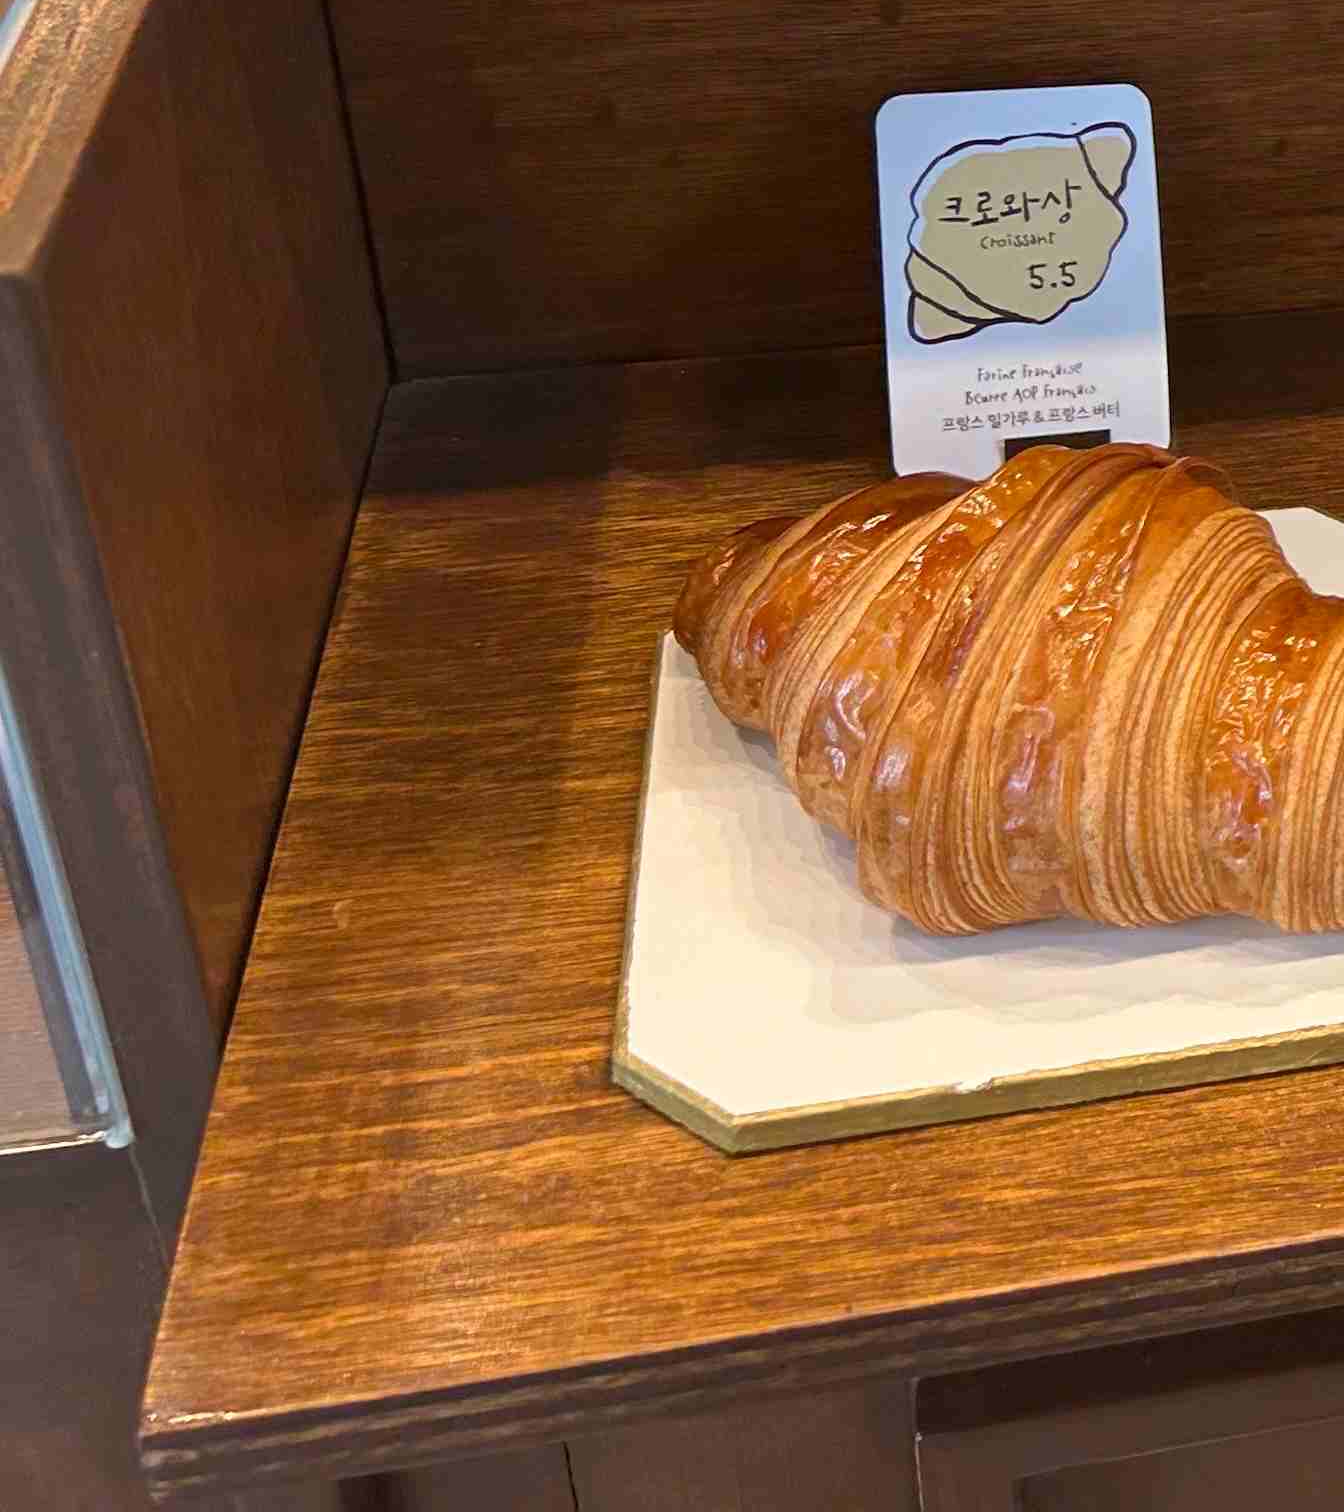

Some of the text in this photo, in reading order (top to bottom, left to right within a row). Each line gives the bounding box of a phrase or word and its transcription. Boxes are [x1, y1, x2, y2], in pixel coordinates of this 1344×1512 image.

[938, 178, 1083, 228] 크로와상
[1026, 261, 1078, 289] 5.5
[941, 414, 985, 433] 프랑스
[986, 410, 1030, 432] 밀가루
[1047, 403, 1091, 426] 프랑스
[1092, 399, 1123, 420] 버터
